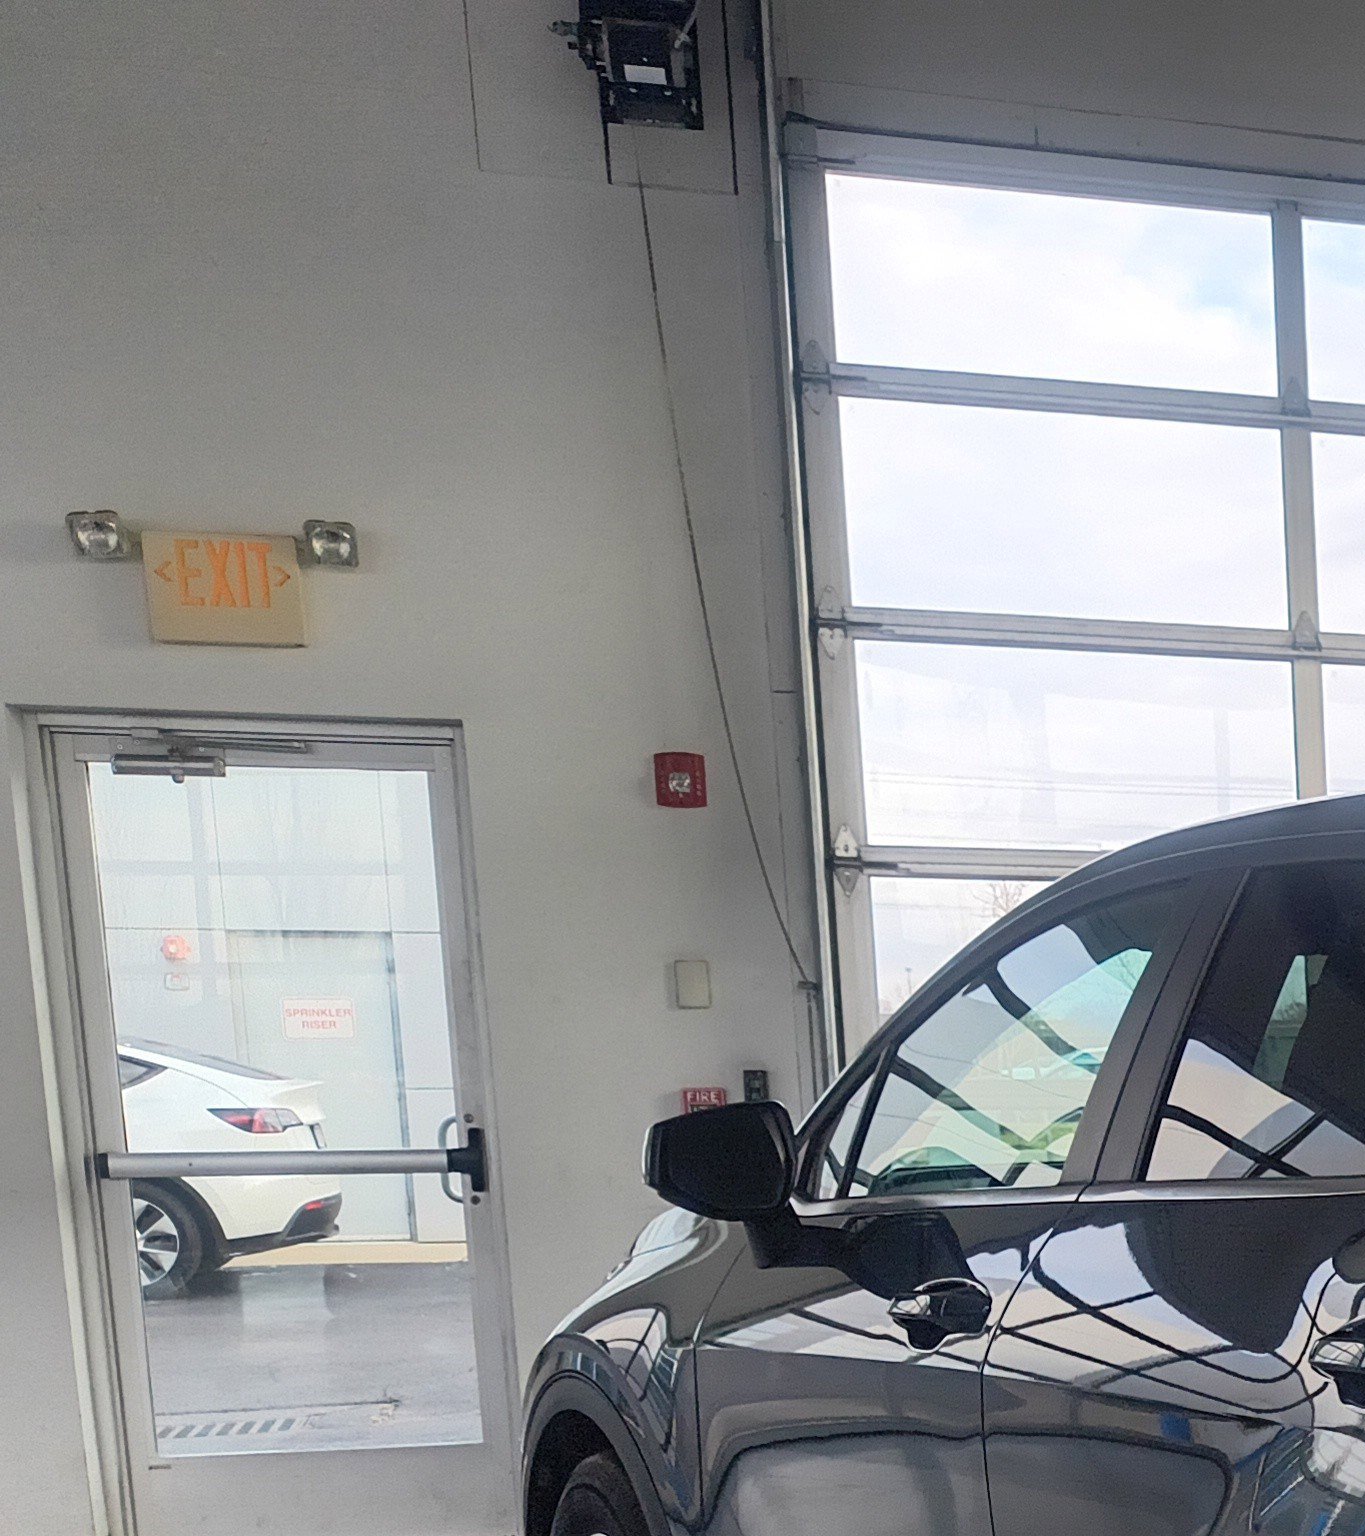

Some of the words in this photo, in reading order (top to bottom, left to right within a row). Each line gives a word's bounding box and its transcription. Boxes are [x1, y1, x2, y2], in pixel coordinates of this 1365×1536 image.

[174, 538, 272, 609] EXIT
[285, 1008, 352, 1017] SPRINKLER
[302, 1020, 336, 1029] RISER
[686, 1091, 720, 1103] FIRE
